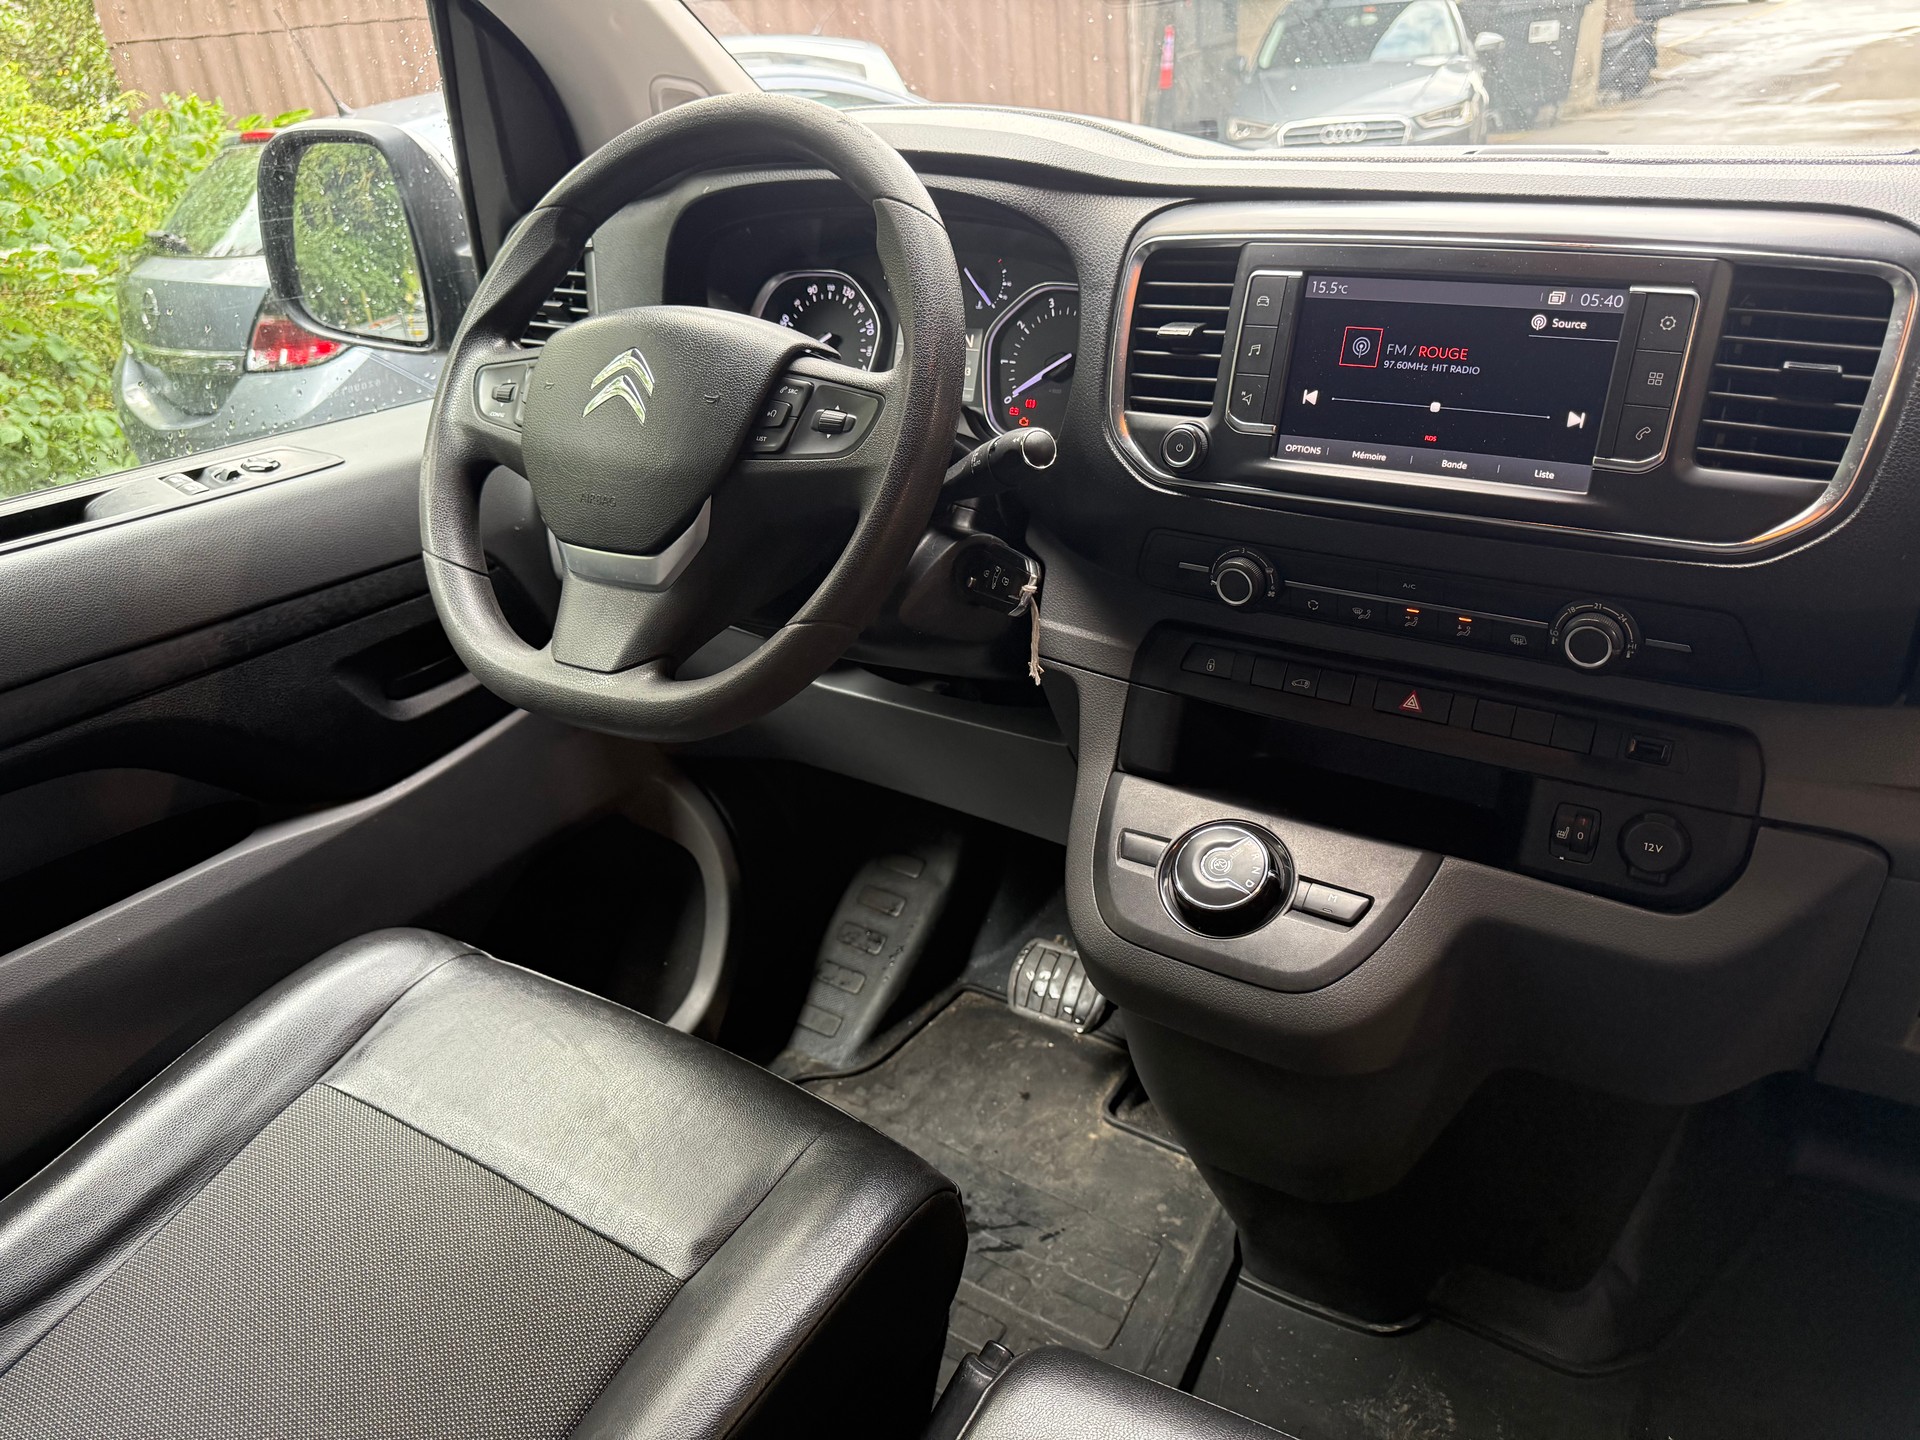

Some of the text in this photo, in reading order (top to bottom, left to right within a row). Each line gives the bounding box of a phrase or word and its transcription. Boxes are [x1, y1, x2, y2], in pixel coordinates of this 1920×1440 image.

[807, 284, 818, 296] 90
[842, 285, 856, 300] 130
[1048, 297, 1055, 308] 3
[1580, 293, 1624, 308] 05:40
[865, 318, 875, 336] 170
[1016, 319, 1026, 330] 2
[1552, 318, 1587, 330] Source
[1386, 343, 1469, 360] FM / ROUGE
[1383, 360, 1480, 375] 97.60MHz HIT RADIO
[1003, 395, 1012, 404] 0
[1285, 444, 1321, 455] OPTIONS
[1351, 450, 1387, 462] Mémoire
[1441, 459, 1468, 470] Bande
[1534, 469, 1555, 480] Liste
[1567, 606, 1576, 614] 18
[1593, 602, 1602, 610] 21
[1617, 613, 1627, 623] 24
[1577, 831, 1584, 840] 0
[1643, 842, 1663, 853] 12V
[1251, 866, 1261, 875] N
[1245, 879, 1255, 888] D
[1327, 893, 1338, 903] M
